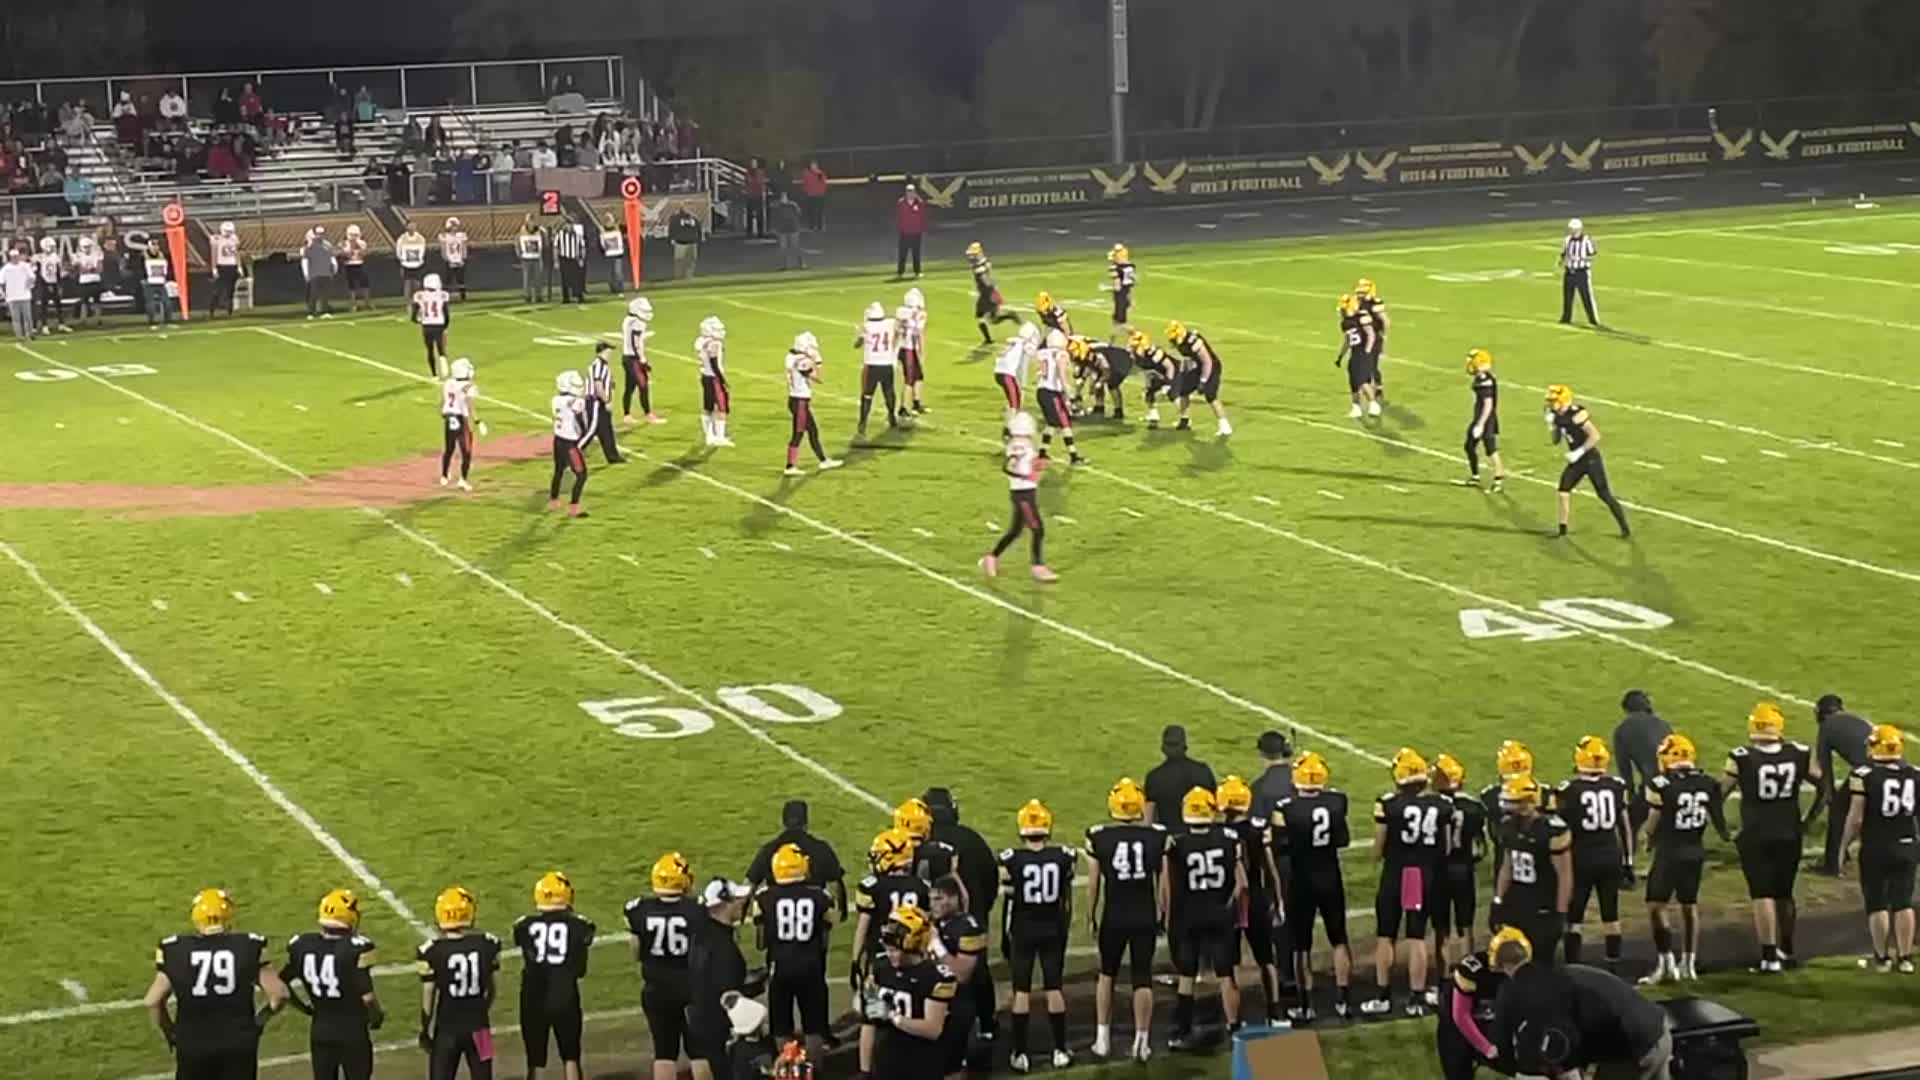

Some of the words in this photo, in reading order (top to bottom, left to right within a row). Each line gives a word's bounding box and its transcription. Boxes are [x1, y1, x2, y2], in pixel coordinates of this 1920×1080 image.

[1440, 165, 1511, 181] FOOTBALL
[1642, 152, 1709, 166] FOOTBALL
[543, 191, 558, 213] 2
[1011, 189, 1088, 206] FOOTBALL
[1190, 180, 1229, 195] 2013
[1231, 176, 1303, 192] FOOTBALL
[422, 300, 439, 319] 14
[871, 331, 889, 353] 74
[1459, 597, 1674, 643] 40
[577, 683, 843, 739] 50
[1758, 762, 1796, 799] 67
[1882, 778, 1916, 817] 64
[1311, 807, 1330, 847] 2
[1401, 805, 1439, 845] 34
[1581, 790, 1616, 830] 30
[1675, 791, 1710, 830] 26
[1112, 841, 1146, 880] 41
[1187, 849, 1225, 890] 25
[1023, 863, 1061, 904] 20
[647, 916, 688, 956] 76
[776, 898, 814, 942] 88
[190, 950, 235, 997] 79
[303, 953, 341, 998] 44
[448, 952, 480, 997] 31
